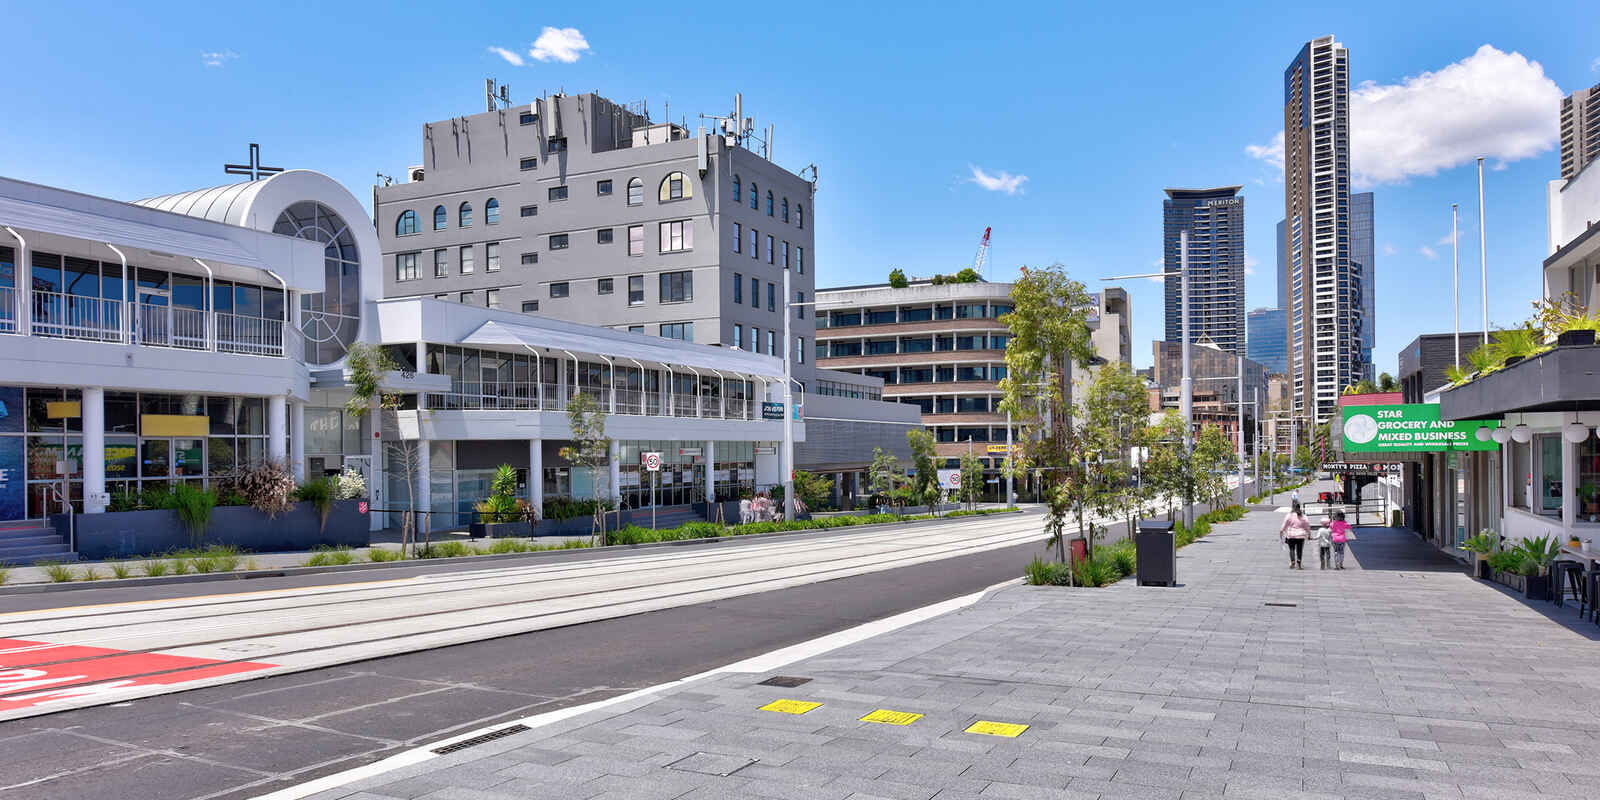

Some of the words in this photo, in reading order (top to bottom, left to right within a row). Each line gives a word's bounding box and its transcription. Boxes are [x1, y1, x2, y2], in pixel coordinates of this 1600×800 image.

[1207, 199, 1240, 207] MERITON
[1377, 410, 1403, 418] STAR
[1377, 421, 1427, 430] GROCERY
[1429, 420, 1455, 429] AND
[1378, 433, 1412, 441] MIXED
[1414, 432, 1467, 441] BUSINESS
[648, 457, 658, 465] 50
